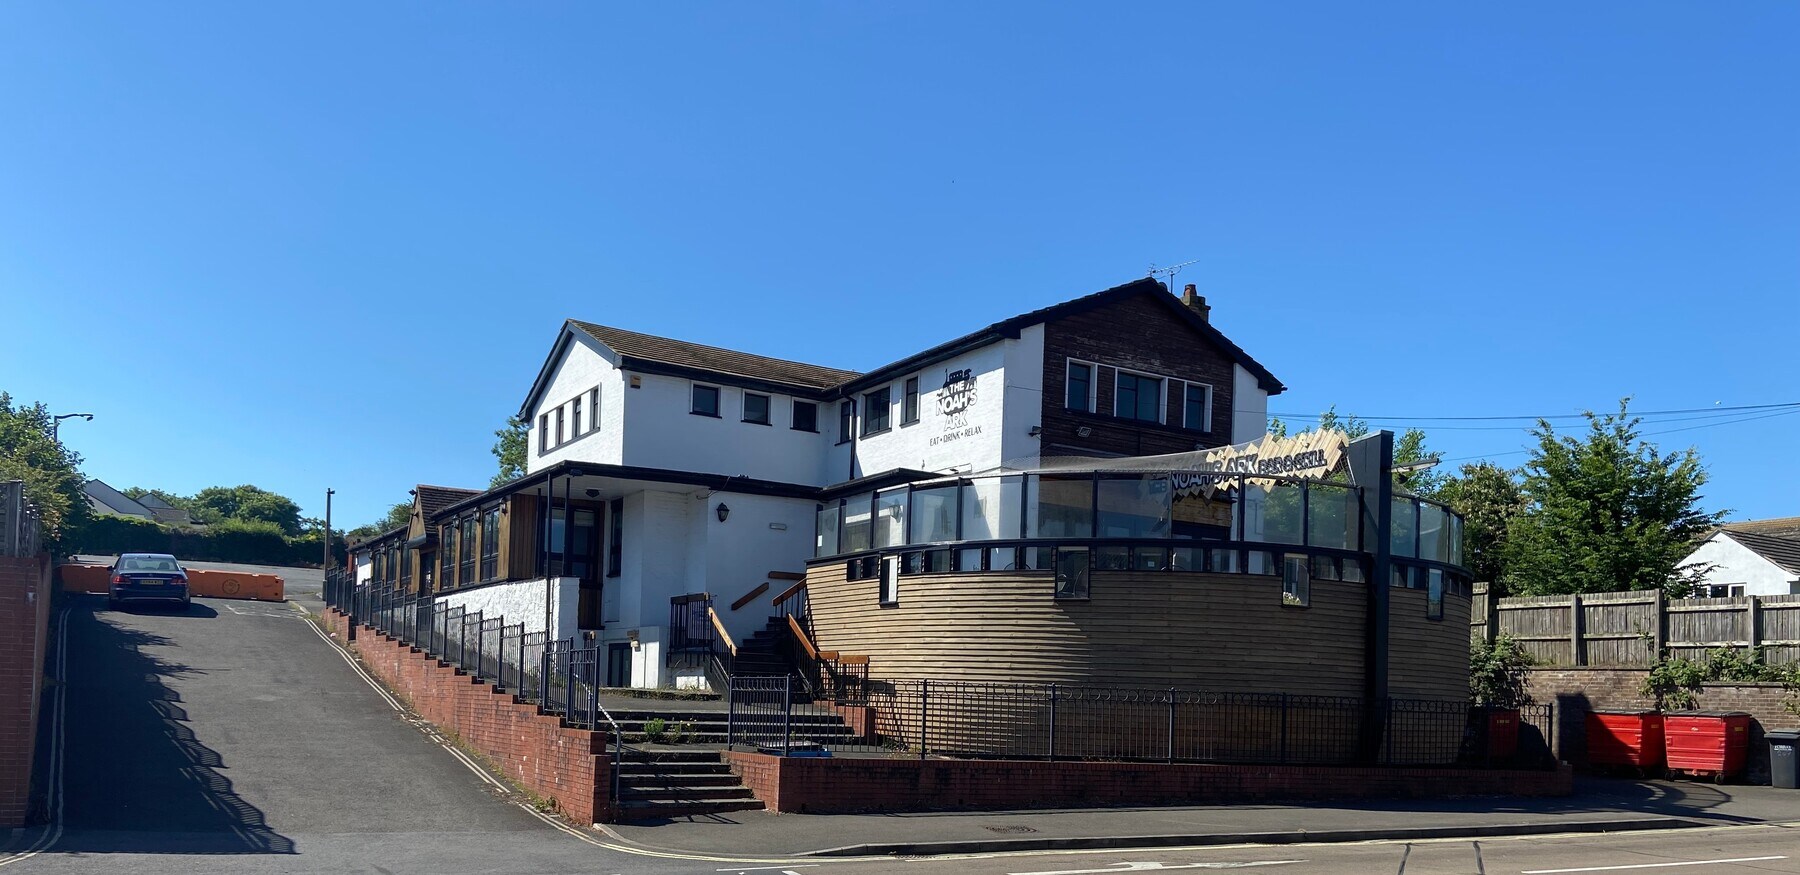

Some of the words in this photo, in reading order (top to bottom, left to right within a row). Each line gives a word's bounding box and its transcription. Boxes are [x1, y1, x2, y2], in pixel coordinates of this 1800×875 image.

[950, 381, 965, 394] THE
[936, 388, 978, 416] NOAH'S
[944, 409, 968, 432] ARK
[929, 437, 940, 446] EAT
[943, 431, 961, 443] DRINK
[964, 426, 982, 437] RELAX
[1224, 453, 1259, 483] ARK
